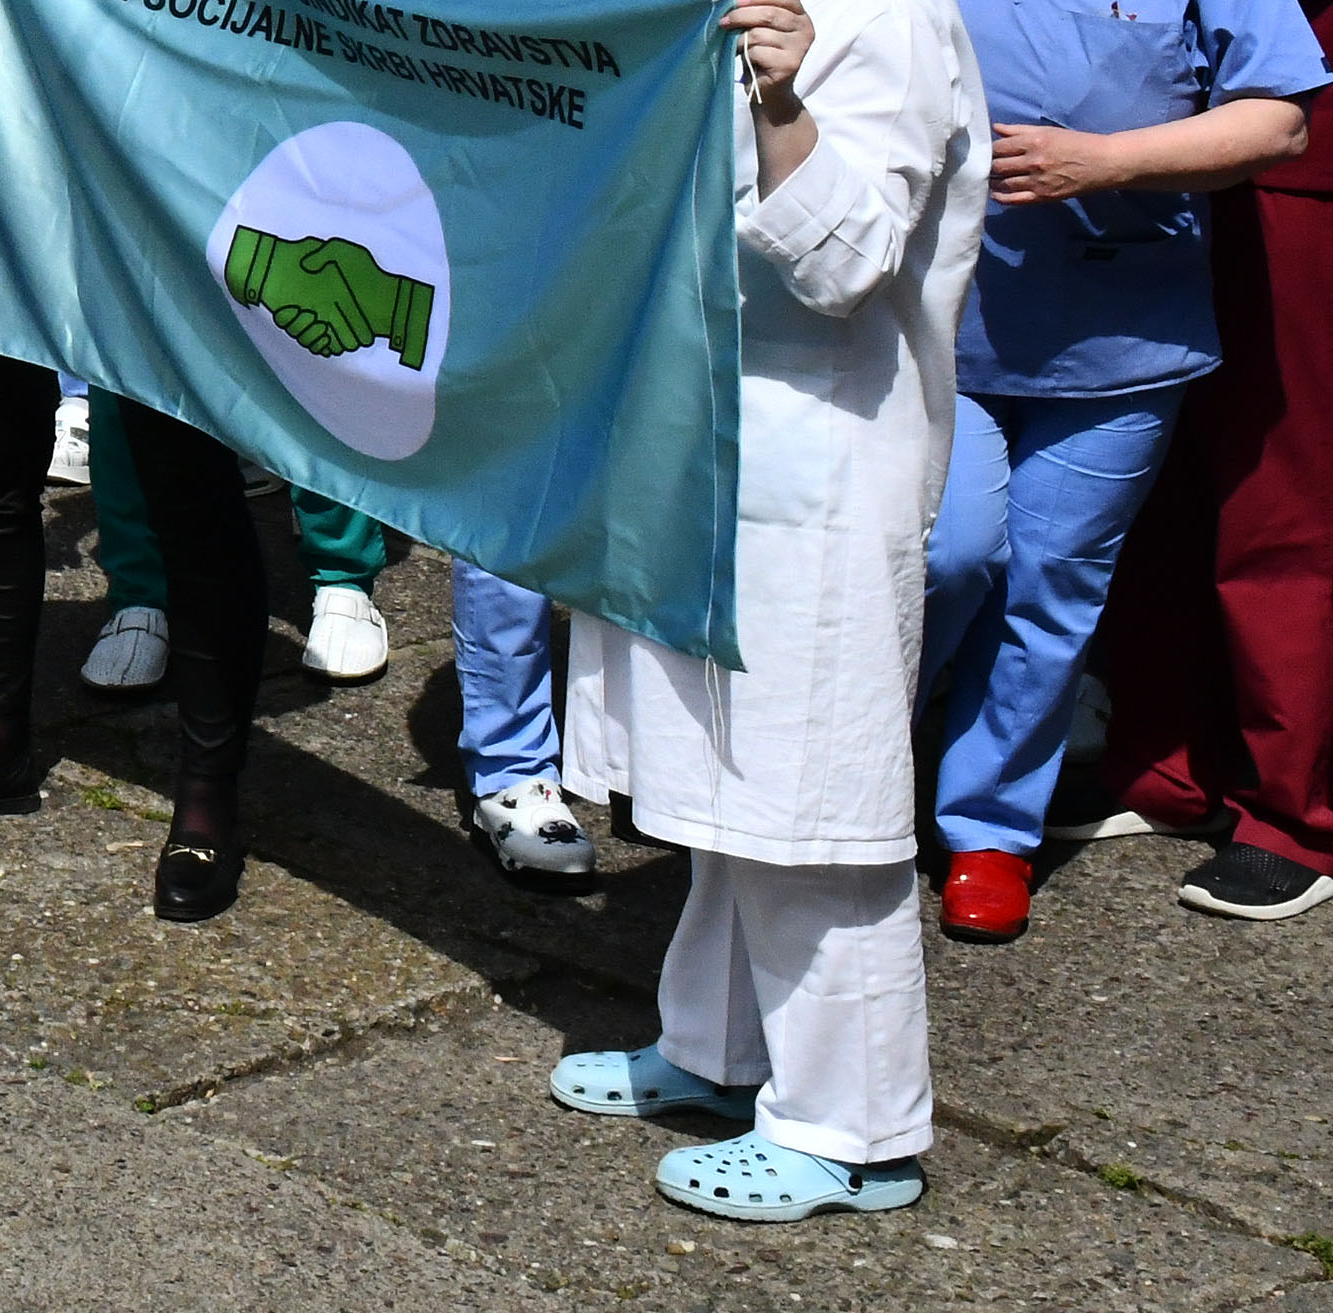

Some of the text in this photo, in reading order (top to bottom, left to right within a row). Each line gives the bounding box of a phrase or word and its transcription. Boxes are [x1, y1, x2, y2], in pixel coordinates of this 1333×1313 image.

[335, 30, 416, 84] SKRBI
[419, 59, 586, 130] HRVATSKE
[412, 13, 621, 78] ZDRAVSTVA
